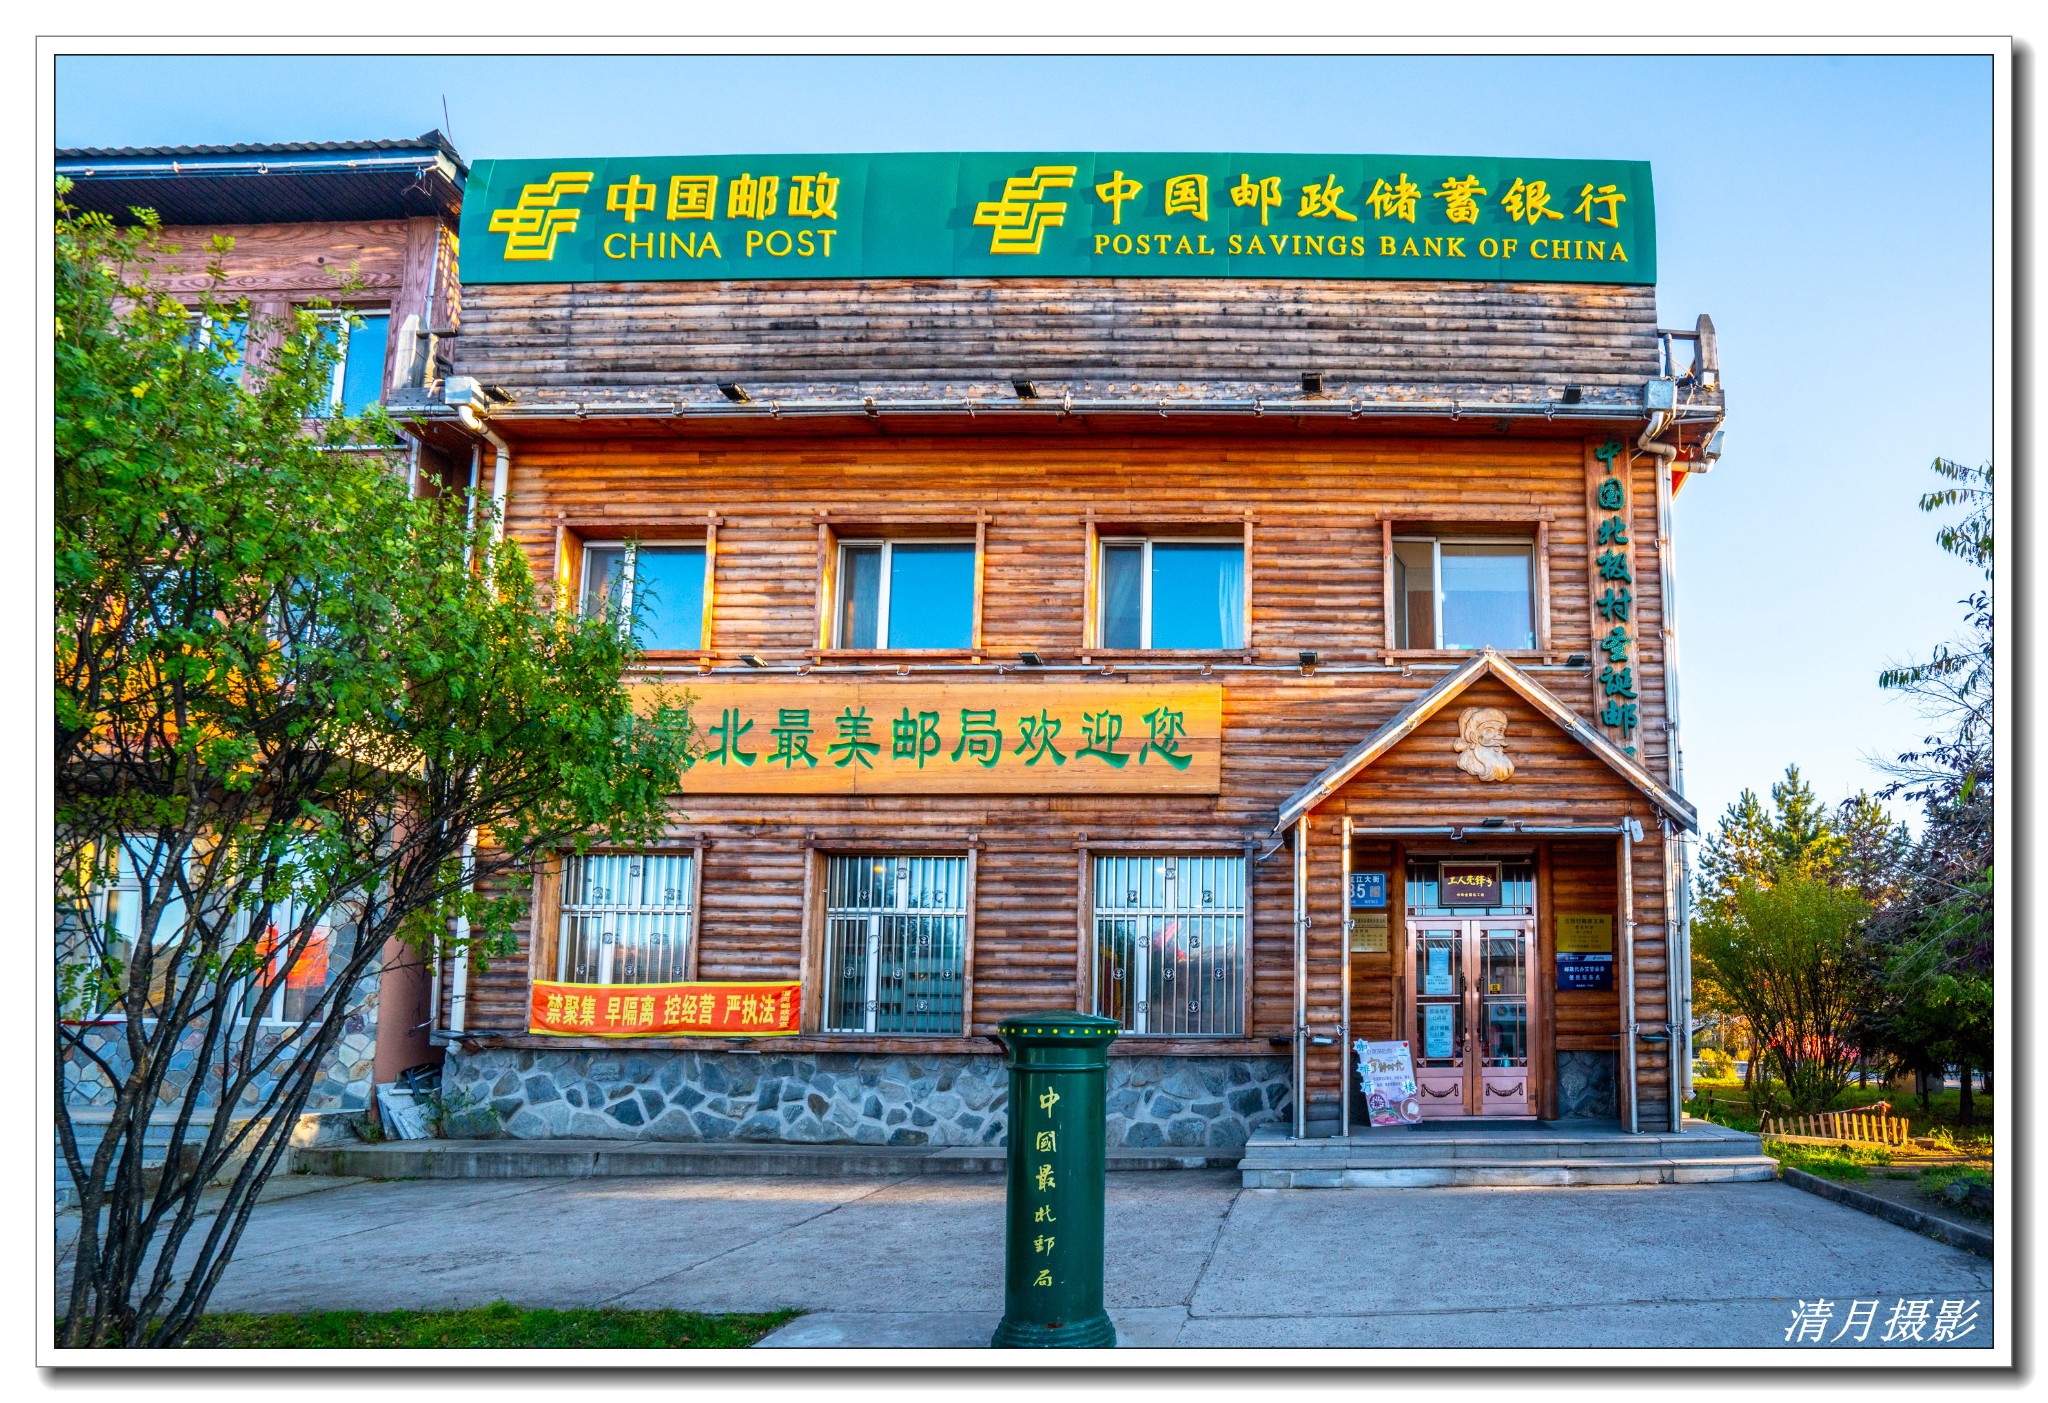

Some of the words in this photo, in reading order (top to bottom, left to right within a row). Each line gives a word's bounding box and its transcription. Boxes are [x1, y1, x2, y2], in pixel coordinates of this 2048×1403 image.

[606, 171, 840, 223] 中国邮政
[1095, 170, 1627, 228] 中国邮政储蓄银行
[603, 232, 721, 260] CHINA
[746, 229, 837, 258] POST
[1095, 234, 1215, 256] POSTAL
[1229, 234, 1365, 257] SAVINGS
[1380, 235, 1466, 258] BANK
[1478, 237, 1518, 259] OF
[1530, 239, 1628, 263] CHINA
[1595, 438, 1638, 757] 中国北极村圣诞邮
[546, 993, 597, 1027] 禁聚集
[605, 995, 656, 1026] 早隔离
[664, 993, 716, 1025] 控经营
[723, 994, 776, 1025] 严执法
